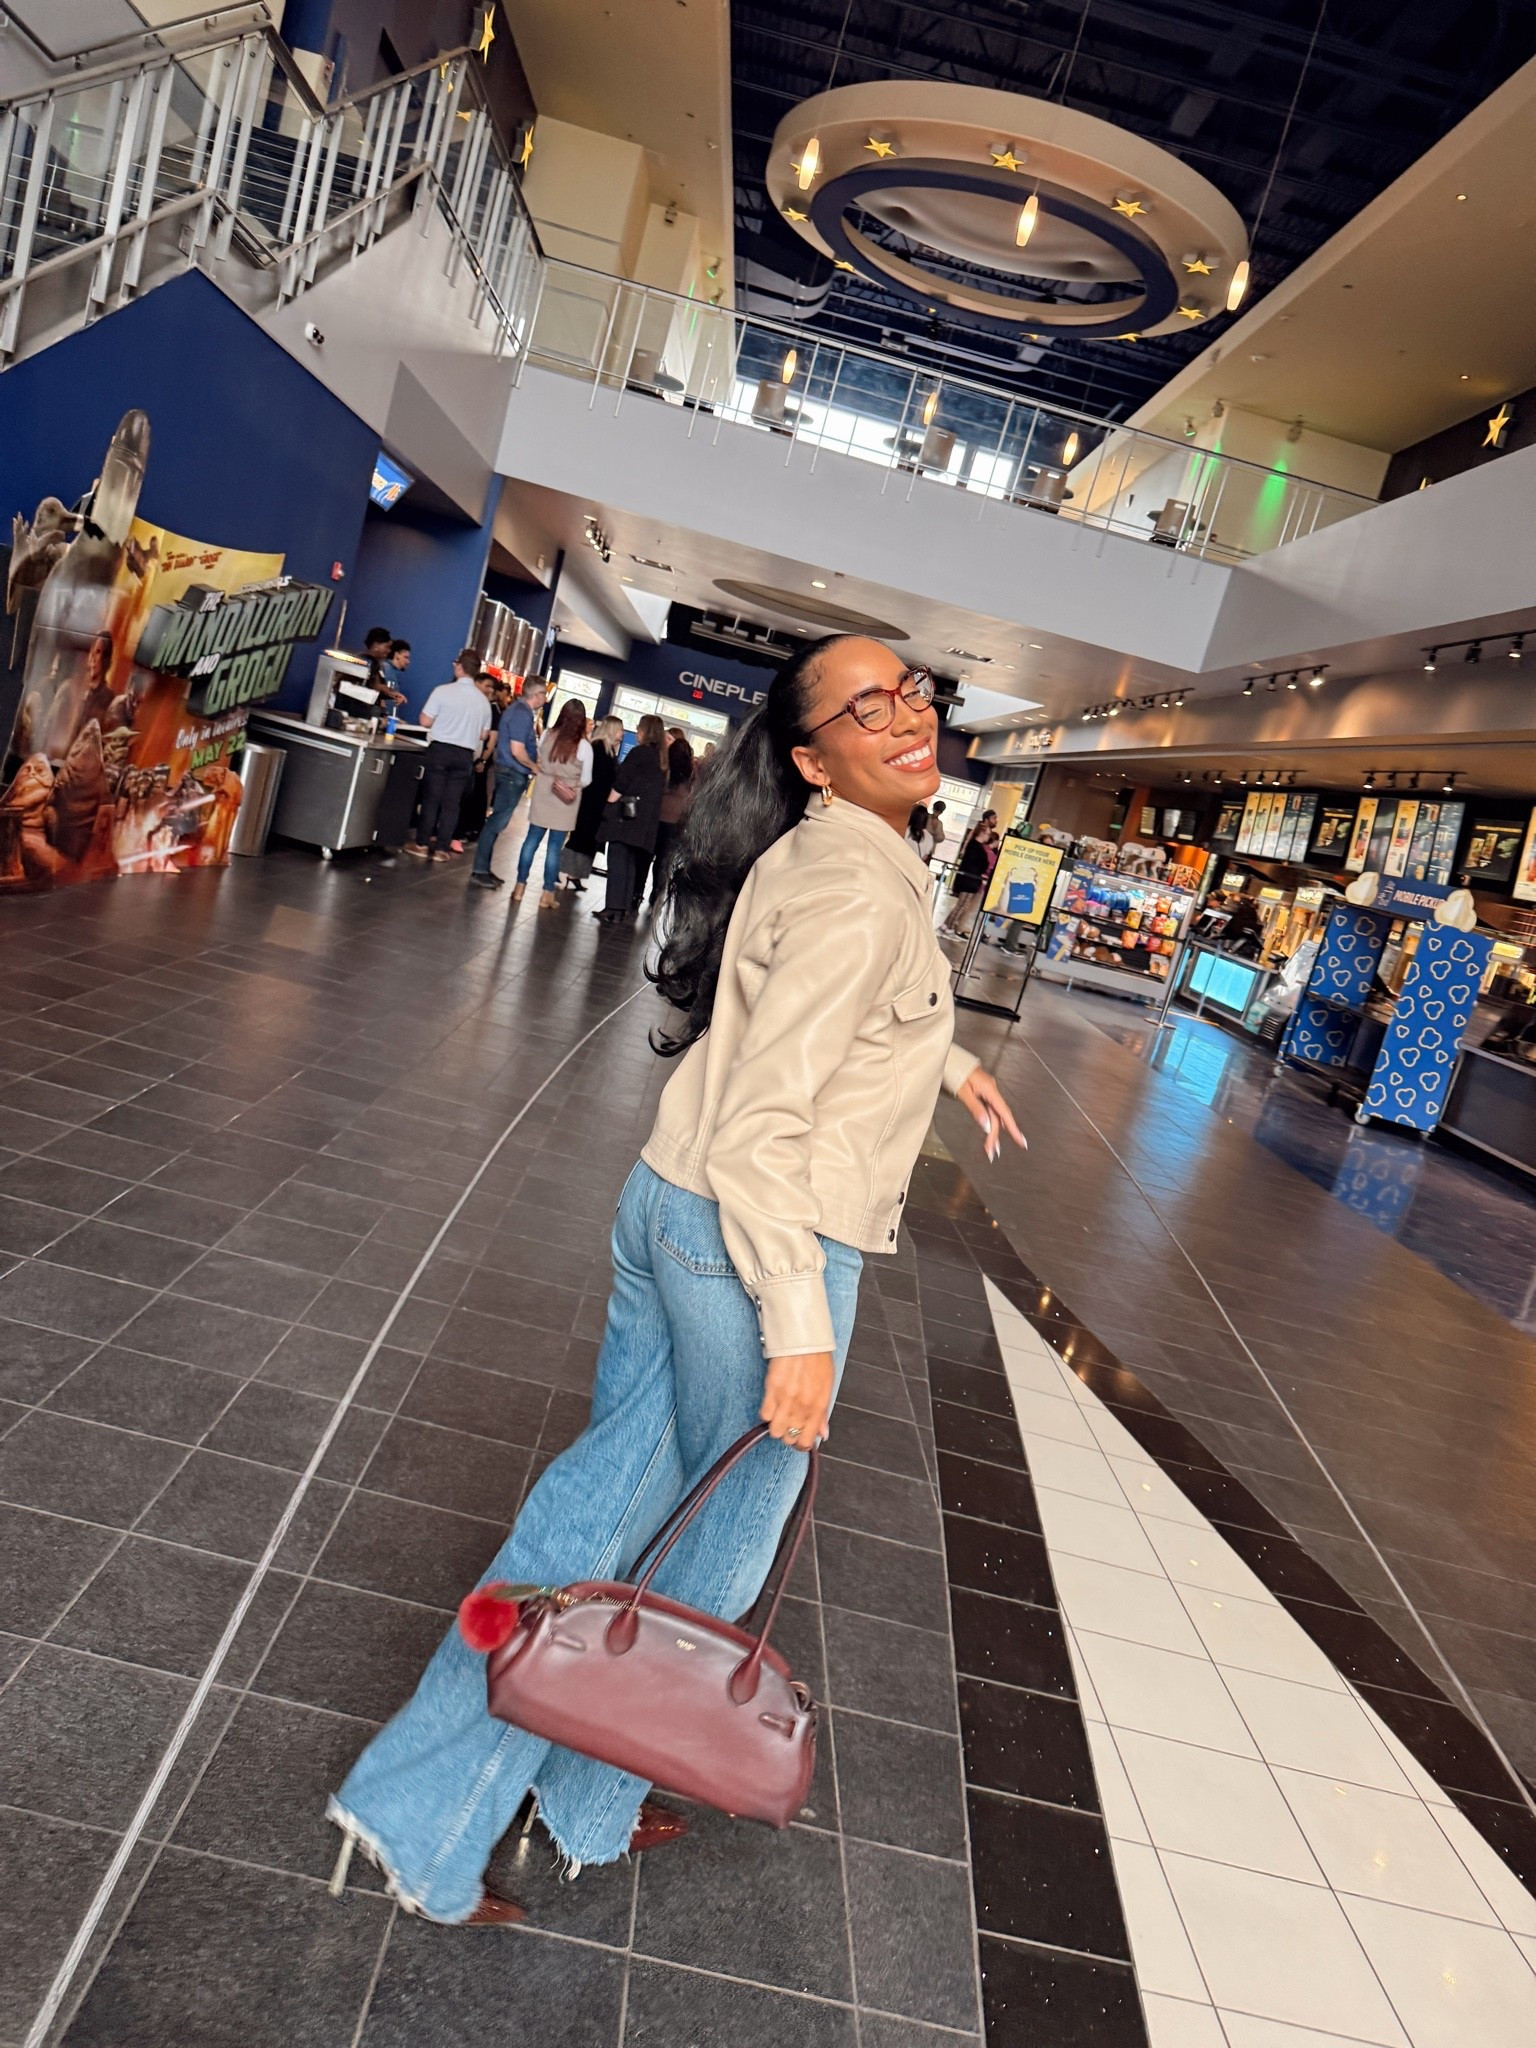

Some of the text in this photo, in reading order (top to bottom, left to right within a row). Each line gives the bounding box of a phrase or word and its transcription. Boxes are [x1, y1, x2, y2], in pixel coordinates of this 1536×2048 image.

[200, 591, 224, 613] THE
[153, 589, 333, 667] MANDALORIAN
[190, 653, 220, 676] AND
[203, 643, 293, 715] GROGU
[679, 671, 768, 705] CINEPLE
[176, 726, 199, 751] Only
[200, 725, 212, 741] in
[192, 731, 246, 769] MAY 22
[1393, 890, 1420, 906] MOBILE
